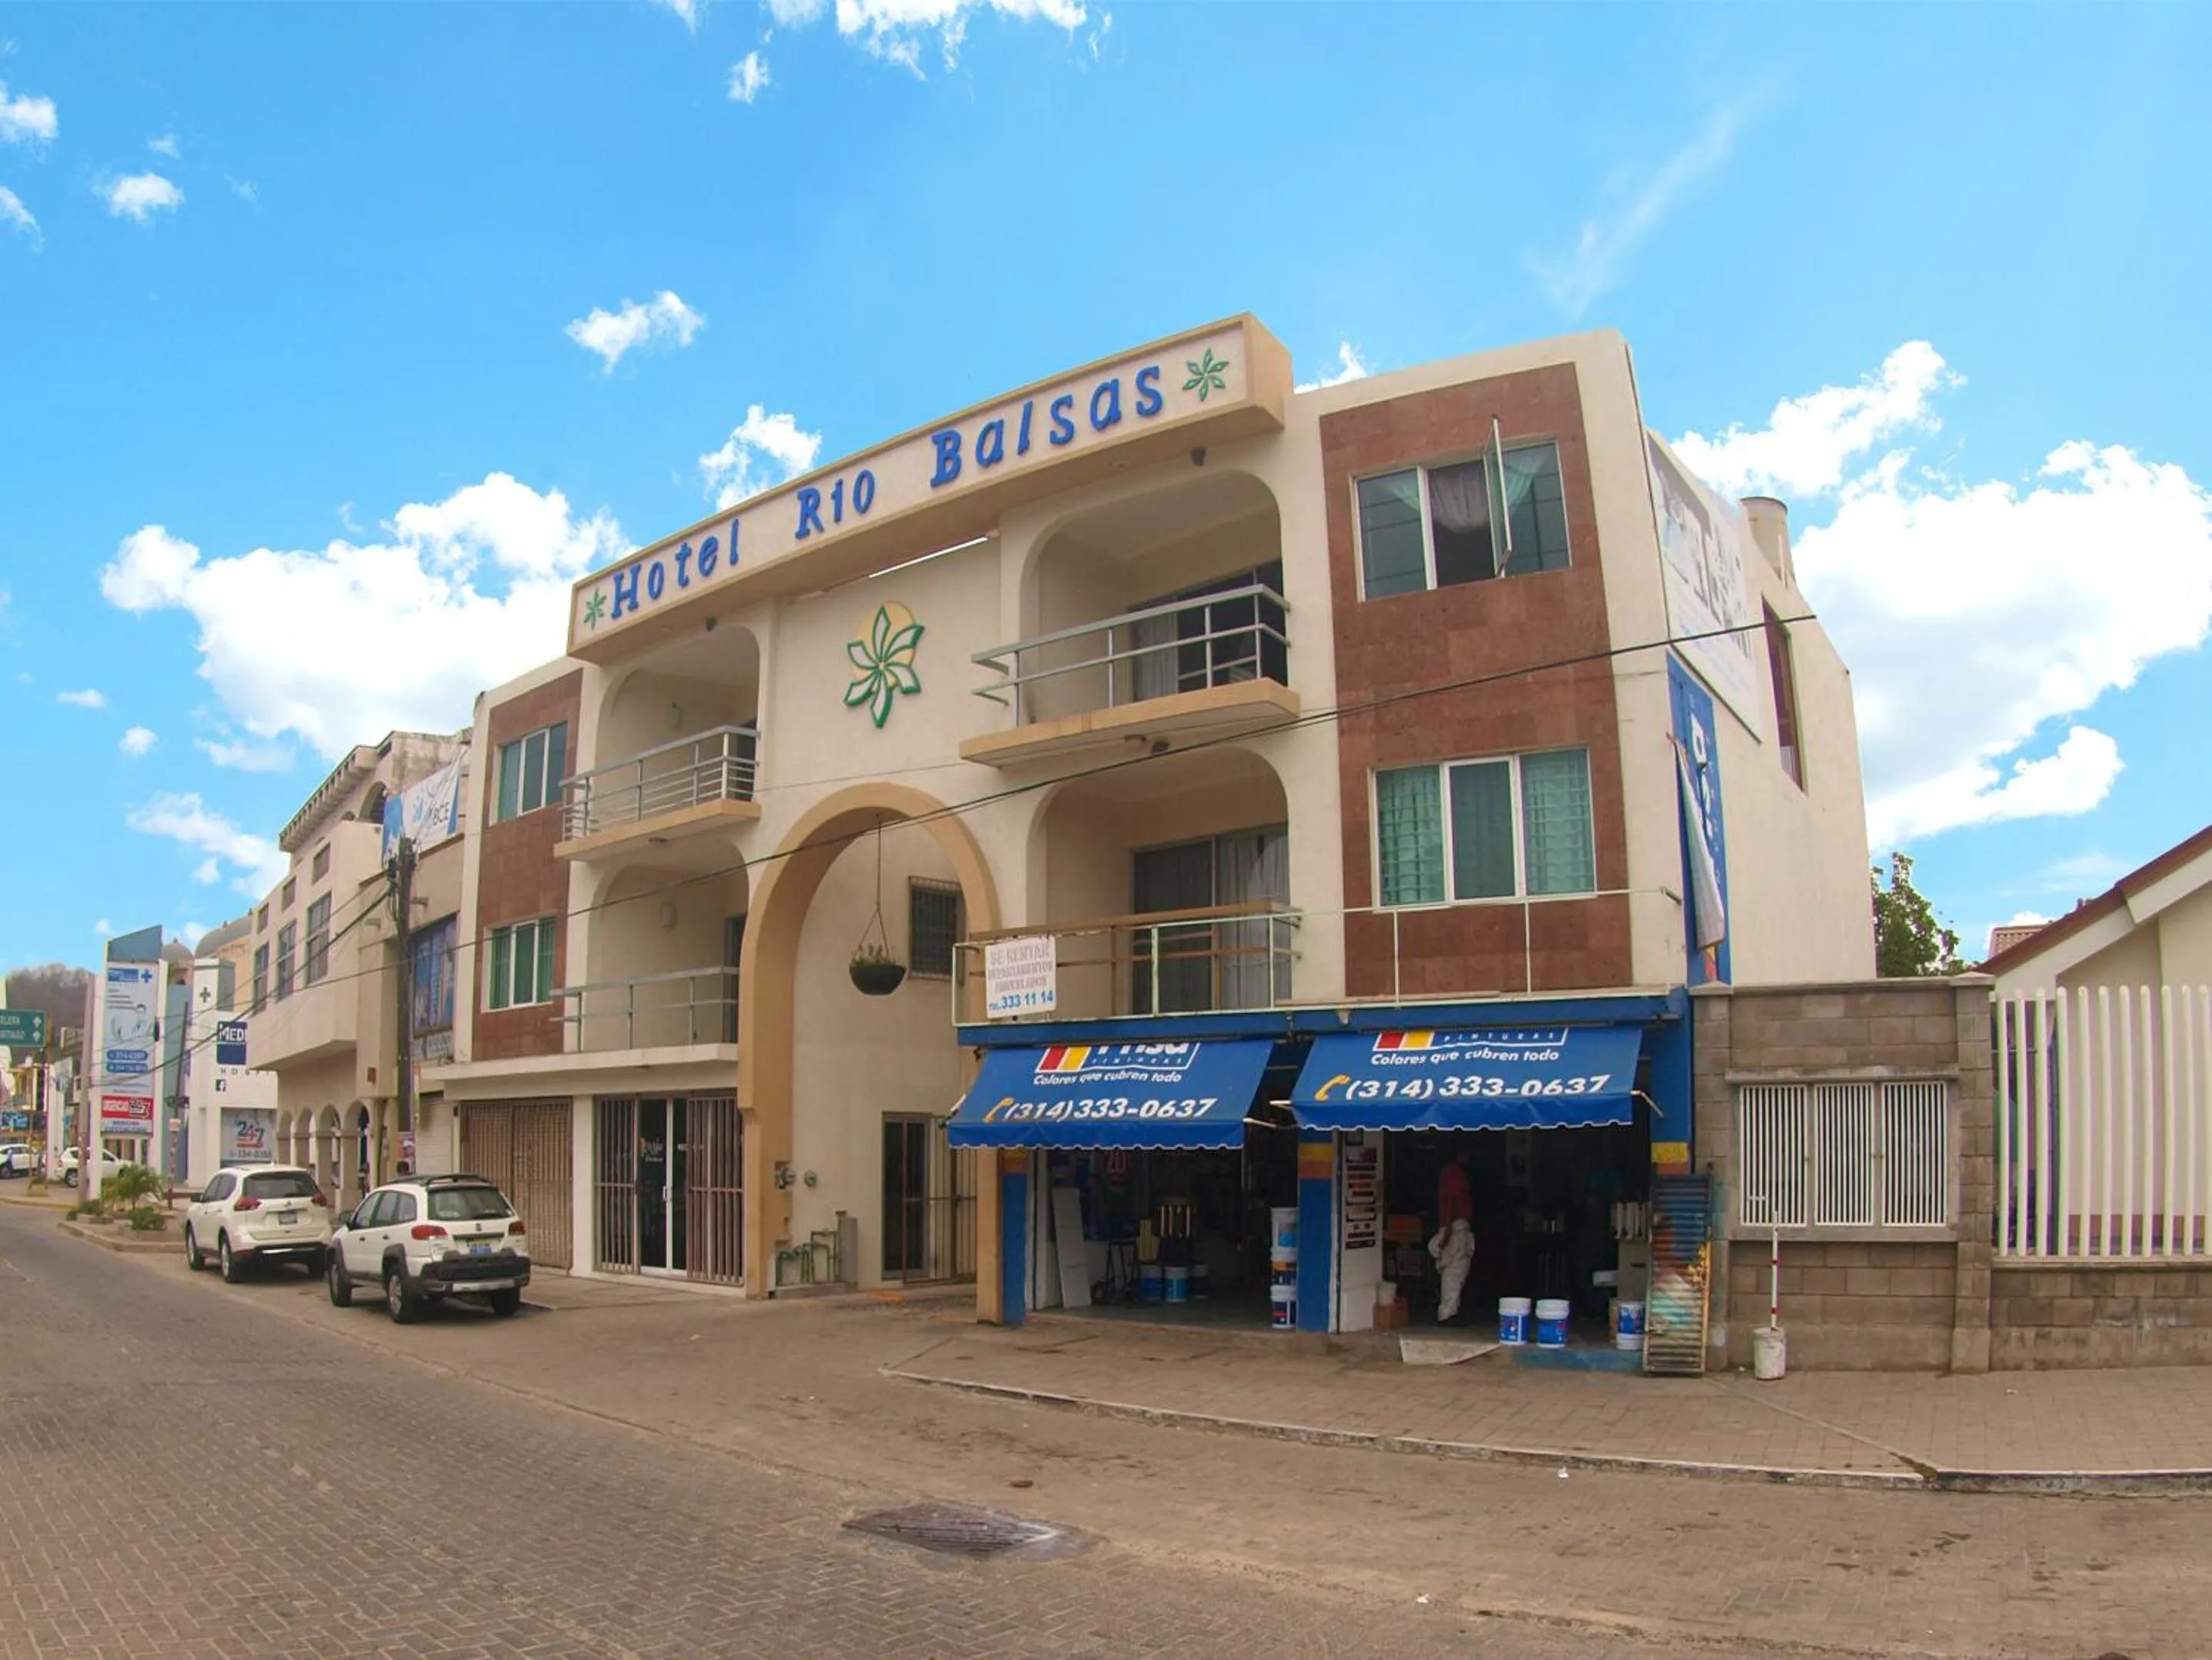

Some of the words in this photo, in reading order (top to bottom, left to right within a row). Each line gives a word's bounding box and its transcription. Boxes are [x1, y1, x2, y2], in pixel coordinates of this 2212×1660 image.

[611, 518, 739, 619] Hotel
[930, 365, 1163, 488] Balsas
[1002, 993, 1021, 1009] 333
[1024, 992, 1036, 1006] 11
[1041, 989, 1053, 1003] 14
[1443, 1032, 1553, 1042] PINTURAS
[1371, 1052, 1426, 1065] Colores
[1430, 1051, 1460, 1063] que
[1465, 1048, 1519, 1061] cubren
[1523, 1049, 1560, 1061] todo
[1033, 1074, 1077, 1085] Colores
[1079, 1072, 1103, 1083] que
[1104, 1071, 1148, 1081] cubren
[1151, 1072, 1182, 1083] todo
